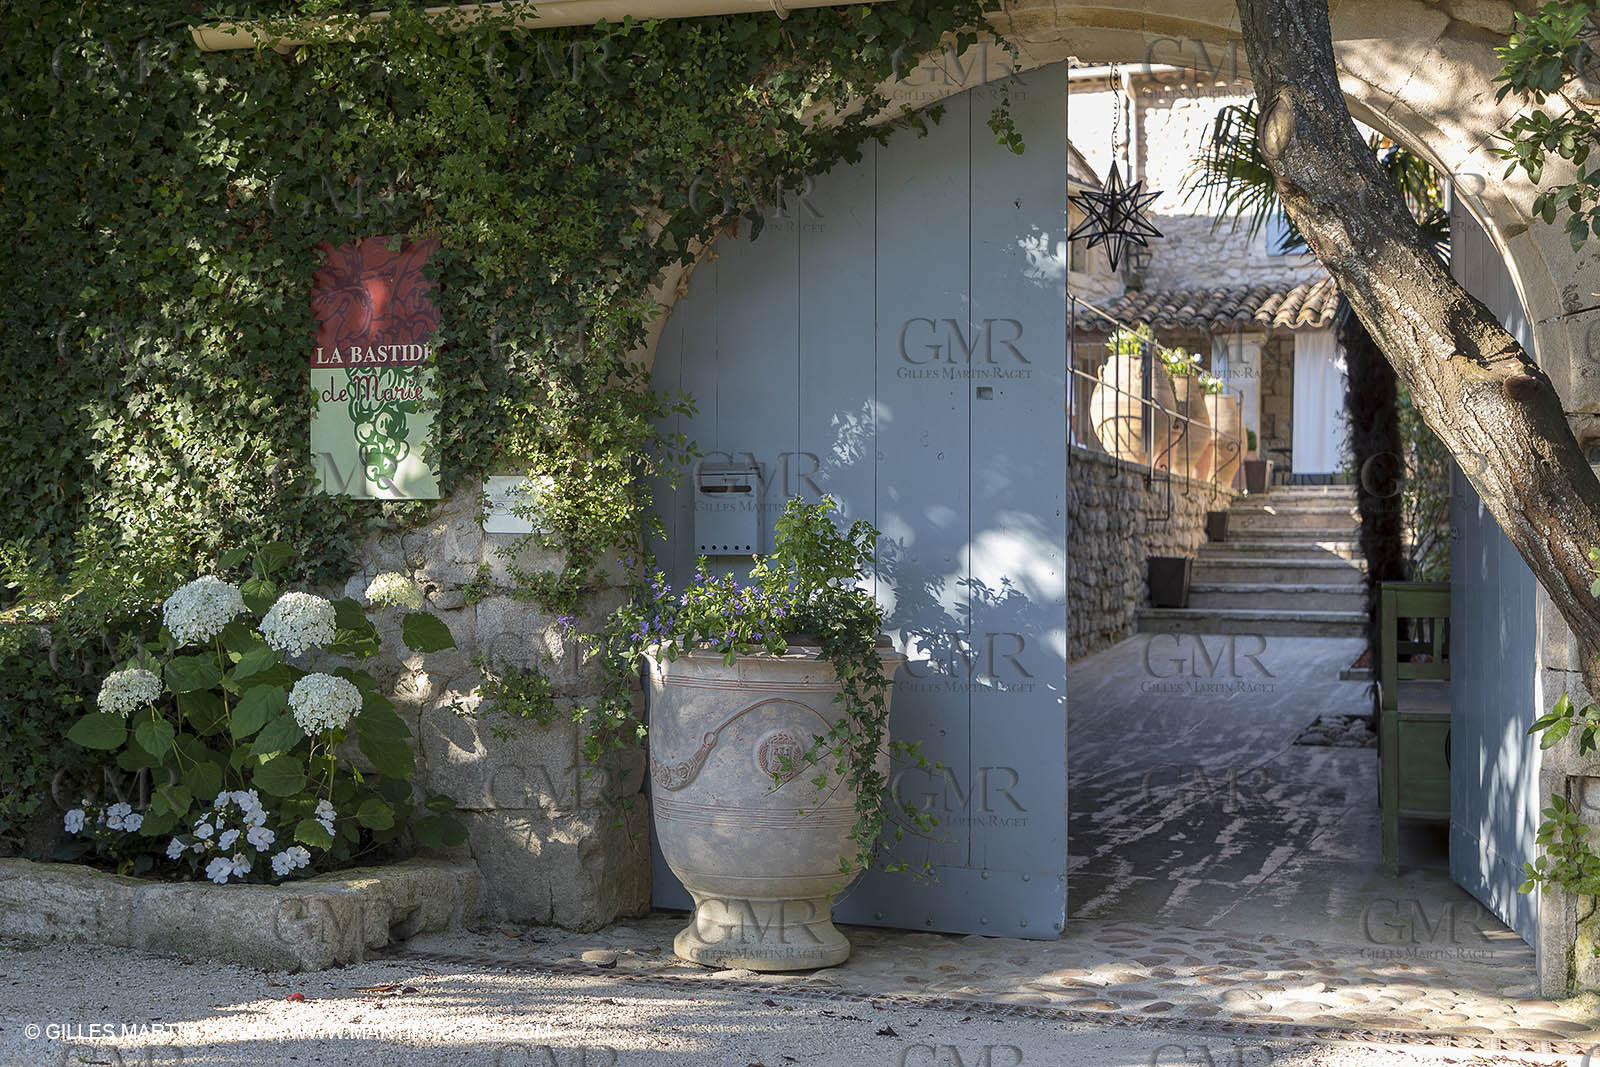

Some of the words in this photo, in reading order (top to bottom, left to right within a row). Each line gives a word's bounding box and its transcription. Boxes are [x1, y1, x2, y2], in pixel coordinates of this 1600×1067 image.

[317, 347, 343, 364] LA
[322, 376, 348, 403] de
[352, 374, 425, 402] Marie
